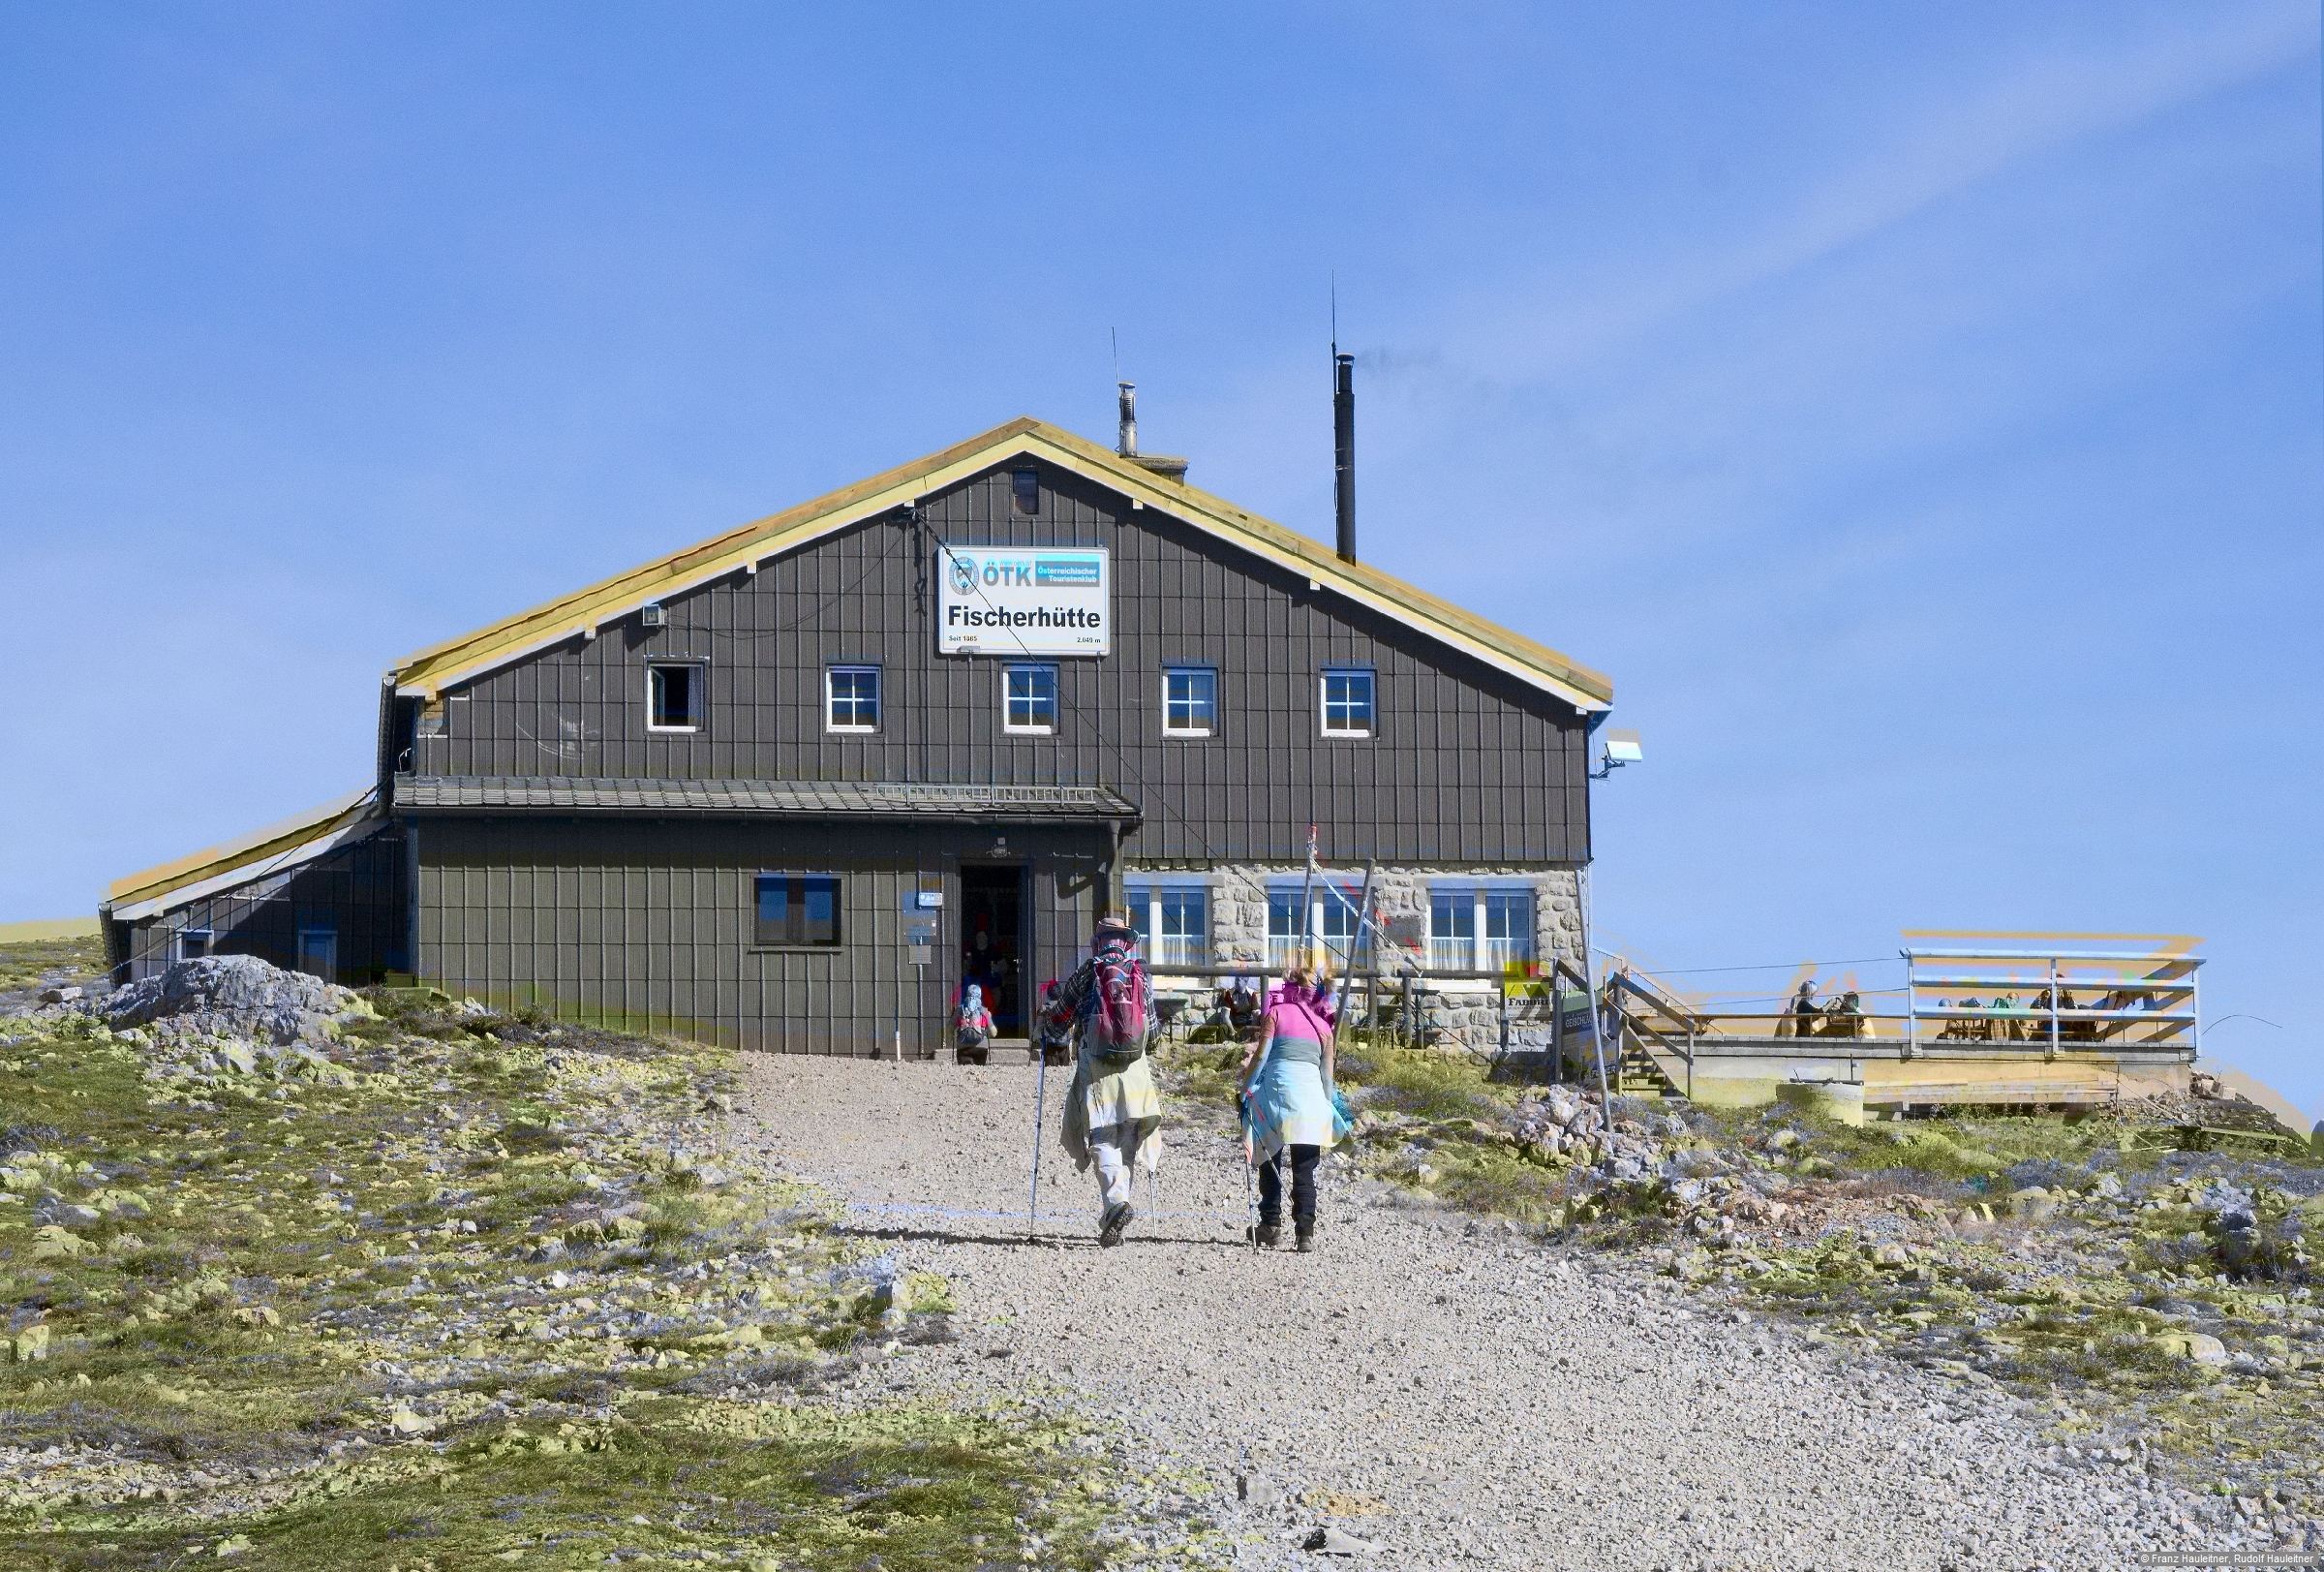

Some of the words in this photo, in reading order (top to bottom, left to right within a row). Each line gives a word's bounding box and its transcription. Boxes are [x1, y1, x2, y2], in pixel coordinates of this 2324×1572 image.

[983, 562, 1032, 587] ÖTK
[1038, 566, 1097, 575] Österreichischer
[1049, 574, 1097, 583] Touristenklub
[948, 605, 1101, 628] Fischerhütte
